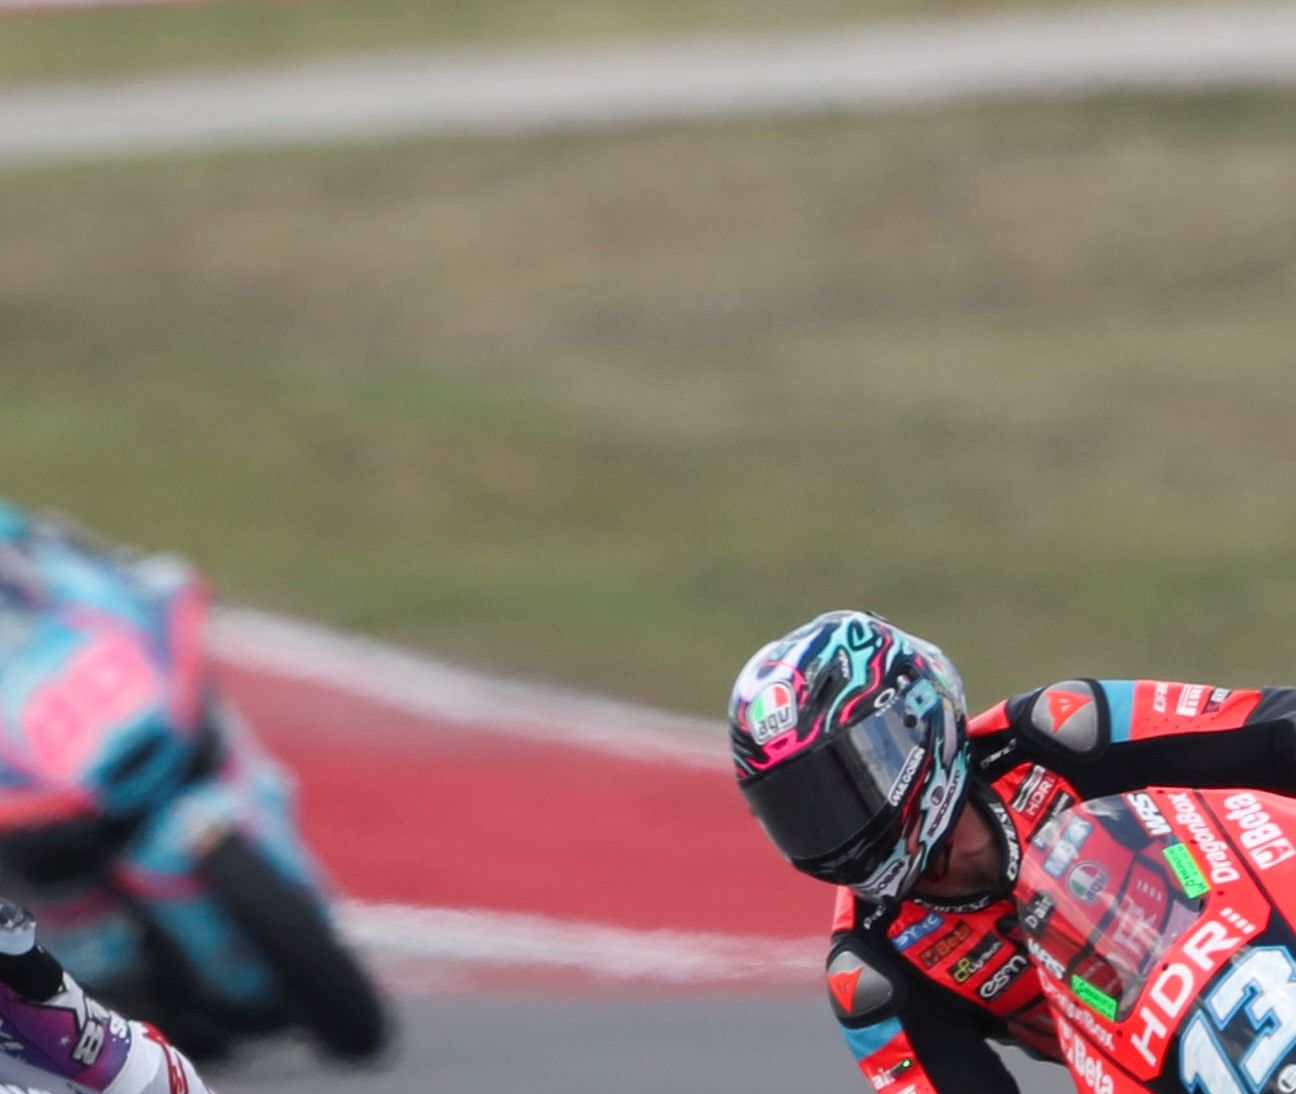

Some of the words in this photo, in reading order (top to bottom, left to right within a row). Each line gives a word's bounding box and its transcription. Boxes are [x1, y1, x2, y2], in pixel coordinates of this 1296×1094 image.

[757, 707, 790, 735] agv
[895, 913, 939, 945] SYC
[980, 954, 1027, 998] esm
[1131, 920, 1242, 1067] HDR
